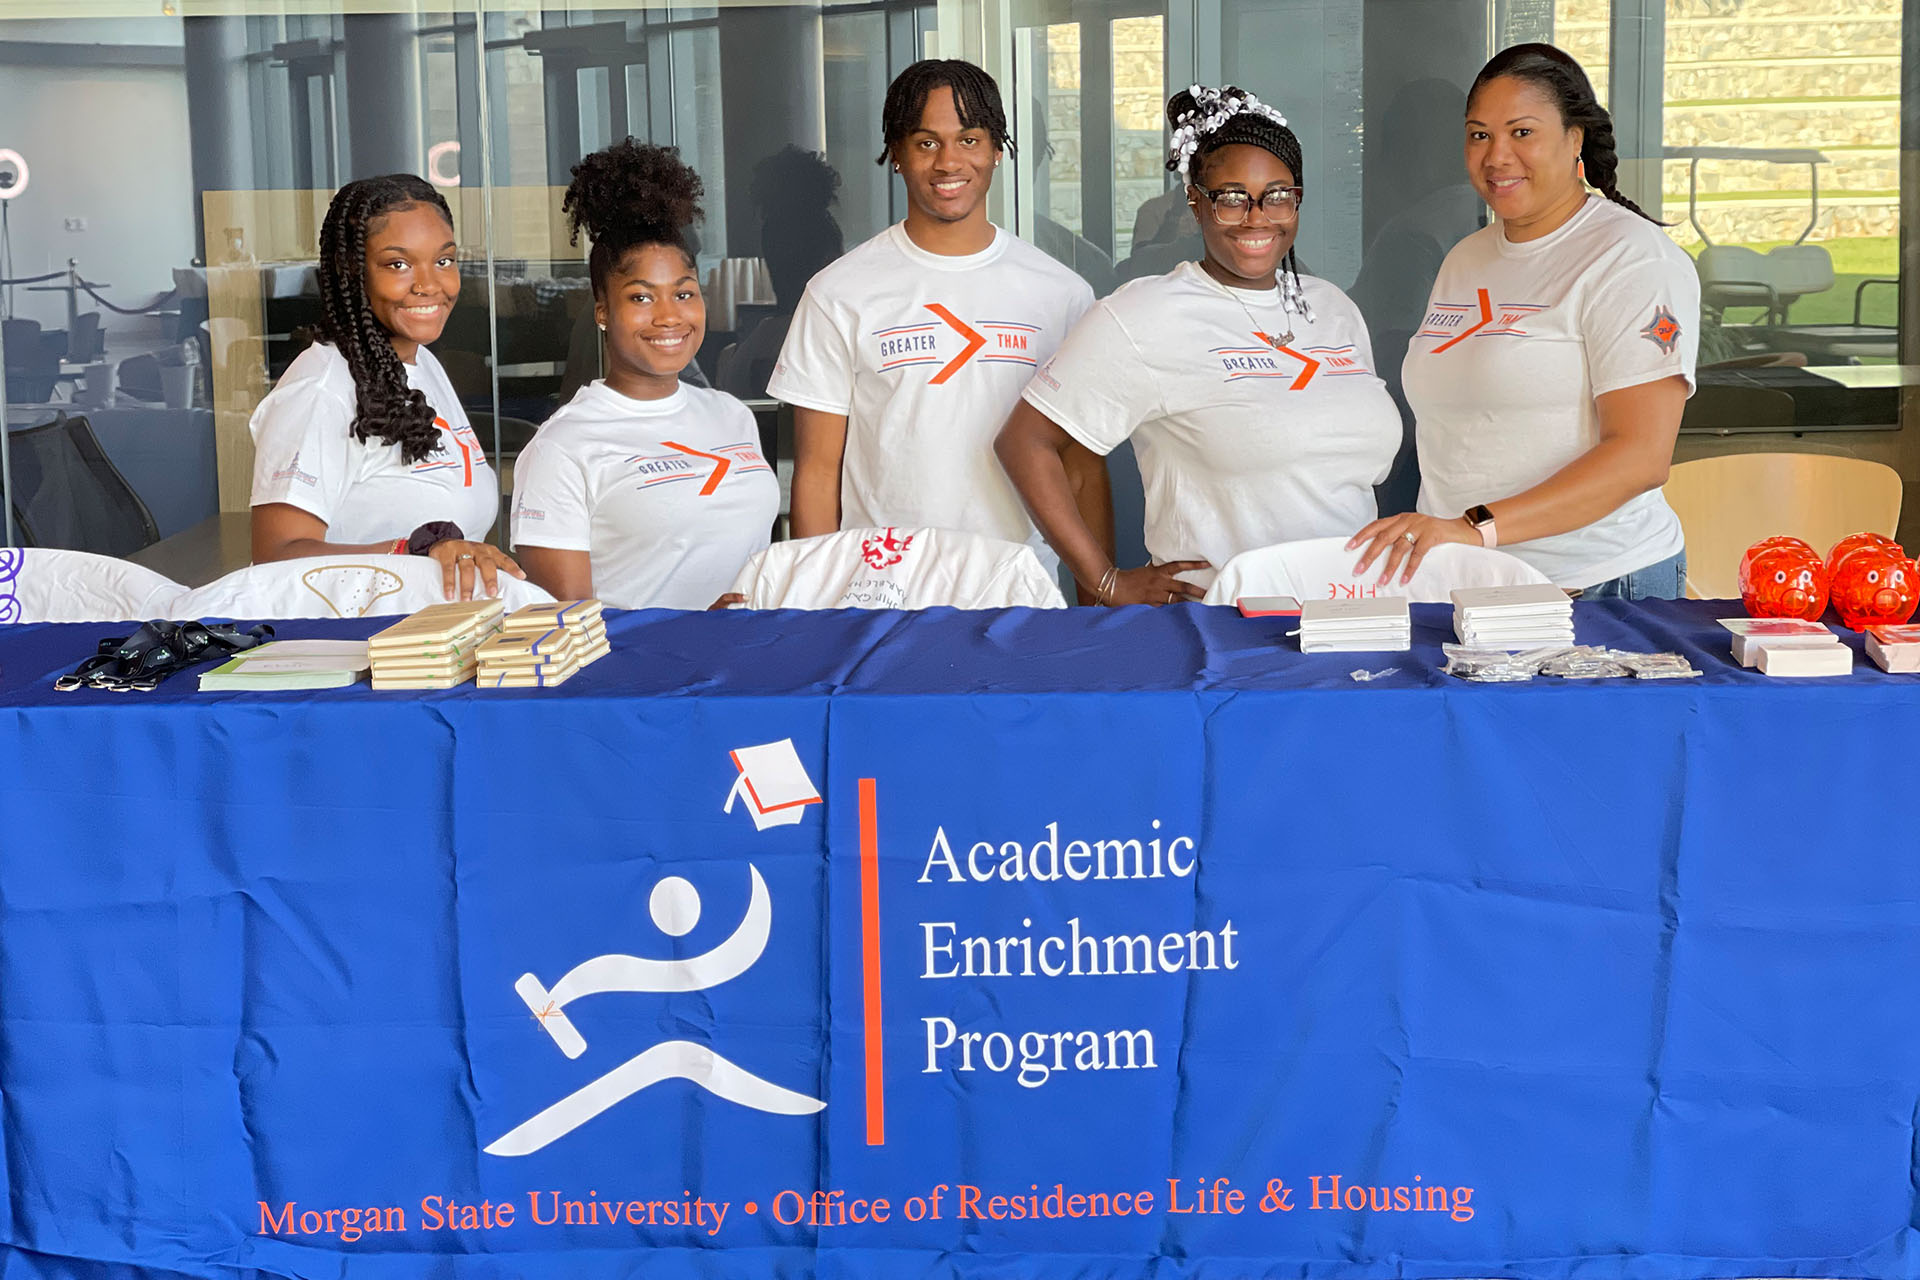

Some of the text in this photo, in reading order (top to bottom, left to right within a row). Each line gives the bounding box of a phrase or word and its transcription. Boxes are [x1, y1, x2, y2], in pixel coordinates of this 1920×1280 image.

[881, 333, 1028, 357] GREATER THAN
[1222, 356, 1356, 371] GREATER THAN
[638, 459, 693, 475] GREATER
[917, 819, 1195, 883] Academic
[918, 917, 1239, 979] Enrichment
[920, 1016, 1158, 1089] Program
[257, 1175, 1475, 1243] Morgan State University Office of Residence Life & Housing
